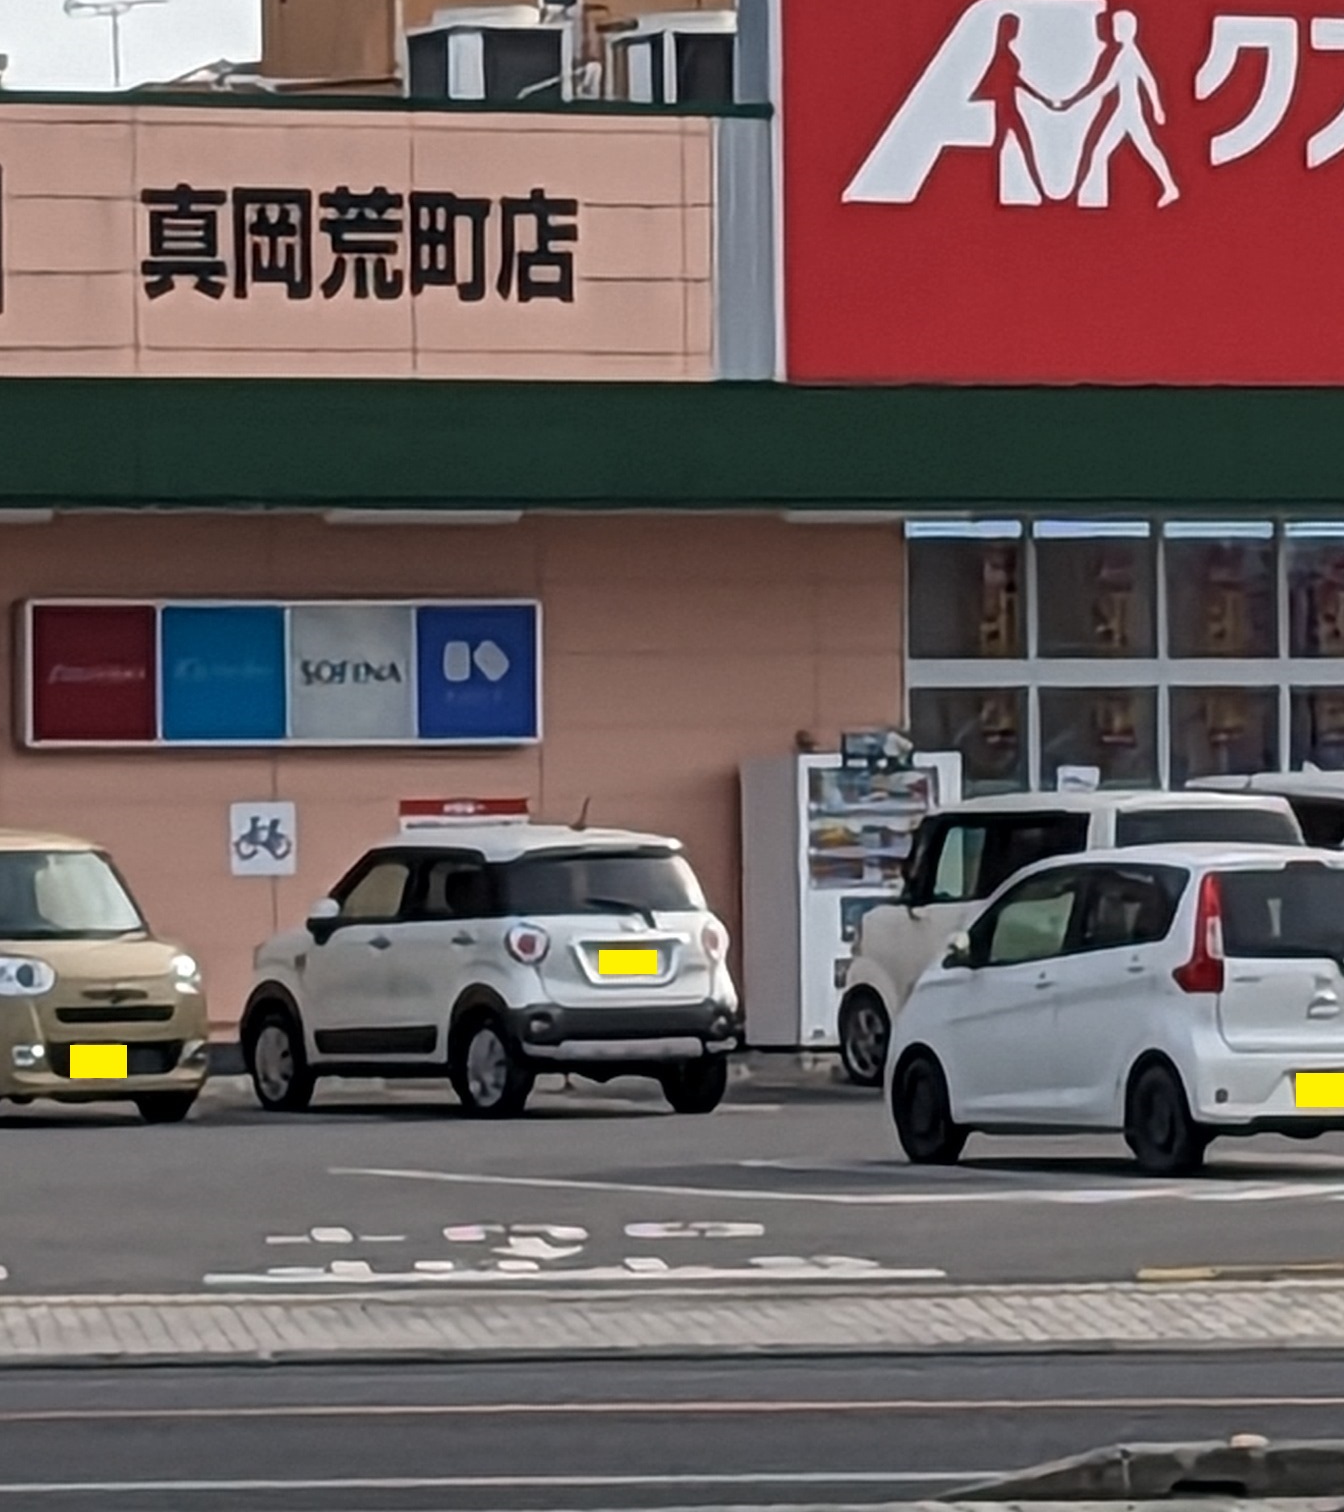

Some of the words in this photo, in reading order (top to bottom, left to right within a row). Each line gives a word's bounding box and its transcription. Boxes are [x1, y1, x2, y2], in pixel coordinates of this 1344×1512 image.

[141, 185, 579, 303] 真岡荒町店
